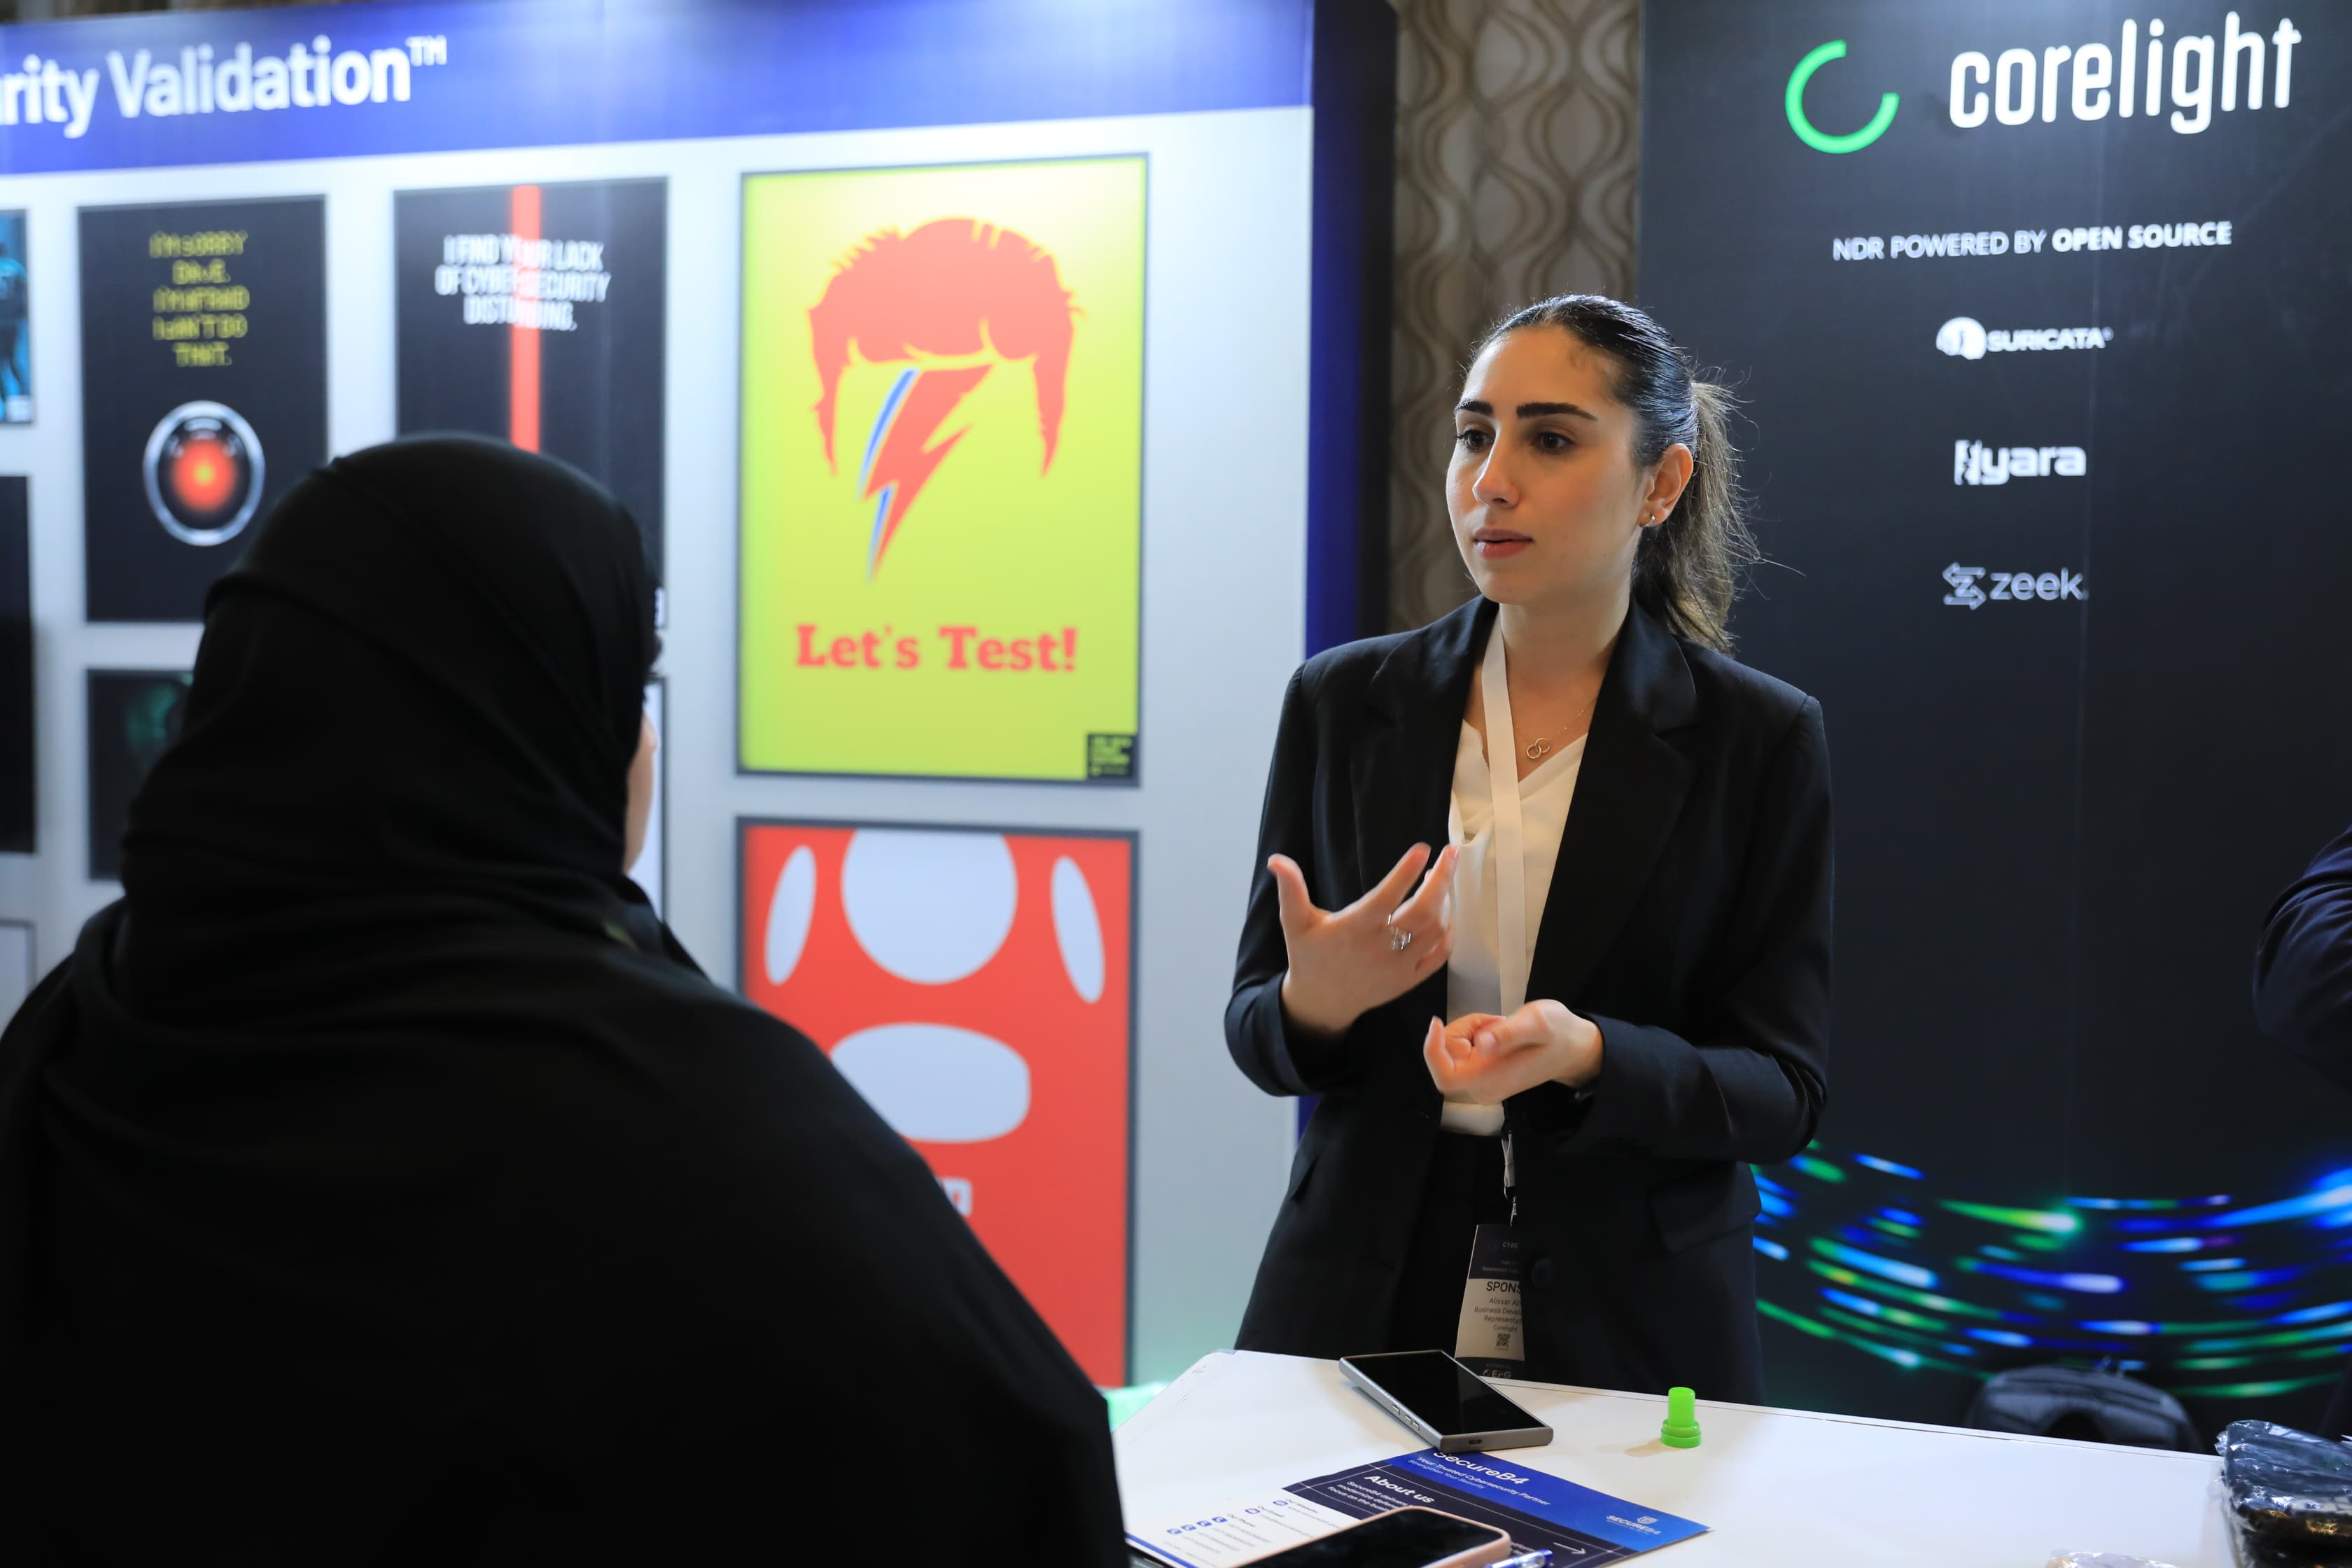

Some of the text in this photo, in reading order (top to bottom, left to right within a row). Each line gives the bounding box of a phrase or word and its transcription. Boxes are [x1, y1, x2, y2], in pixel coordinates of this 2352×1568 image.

[1949, 10, 2302, 134] corelight
[0, 54, 99, 139] rity
[552, 239, 605, 272] LACK
[1833, 220, 2232, 261] NDR POWERED BY OPEN SOURCE
[795, 622, 1079, 672] Let's Test!
[1364, 1476, 1434, 1503] About us
[1418, 1457, 1551, 1505] Your Trusted Cybersecurity Partner
